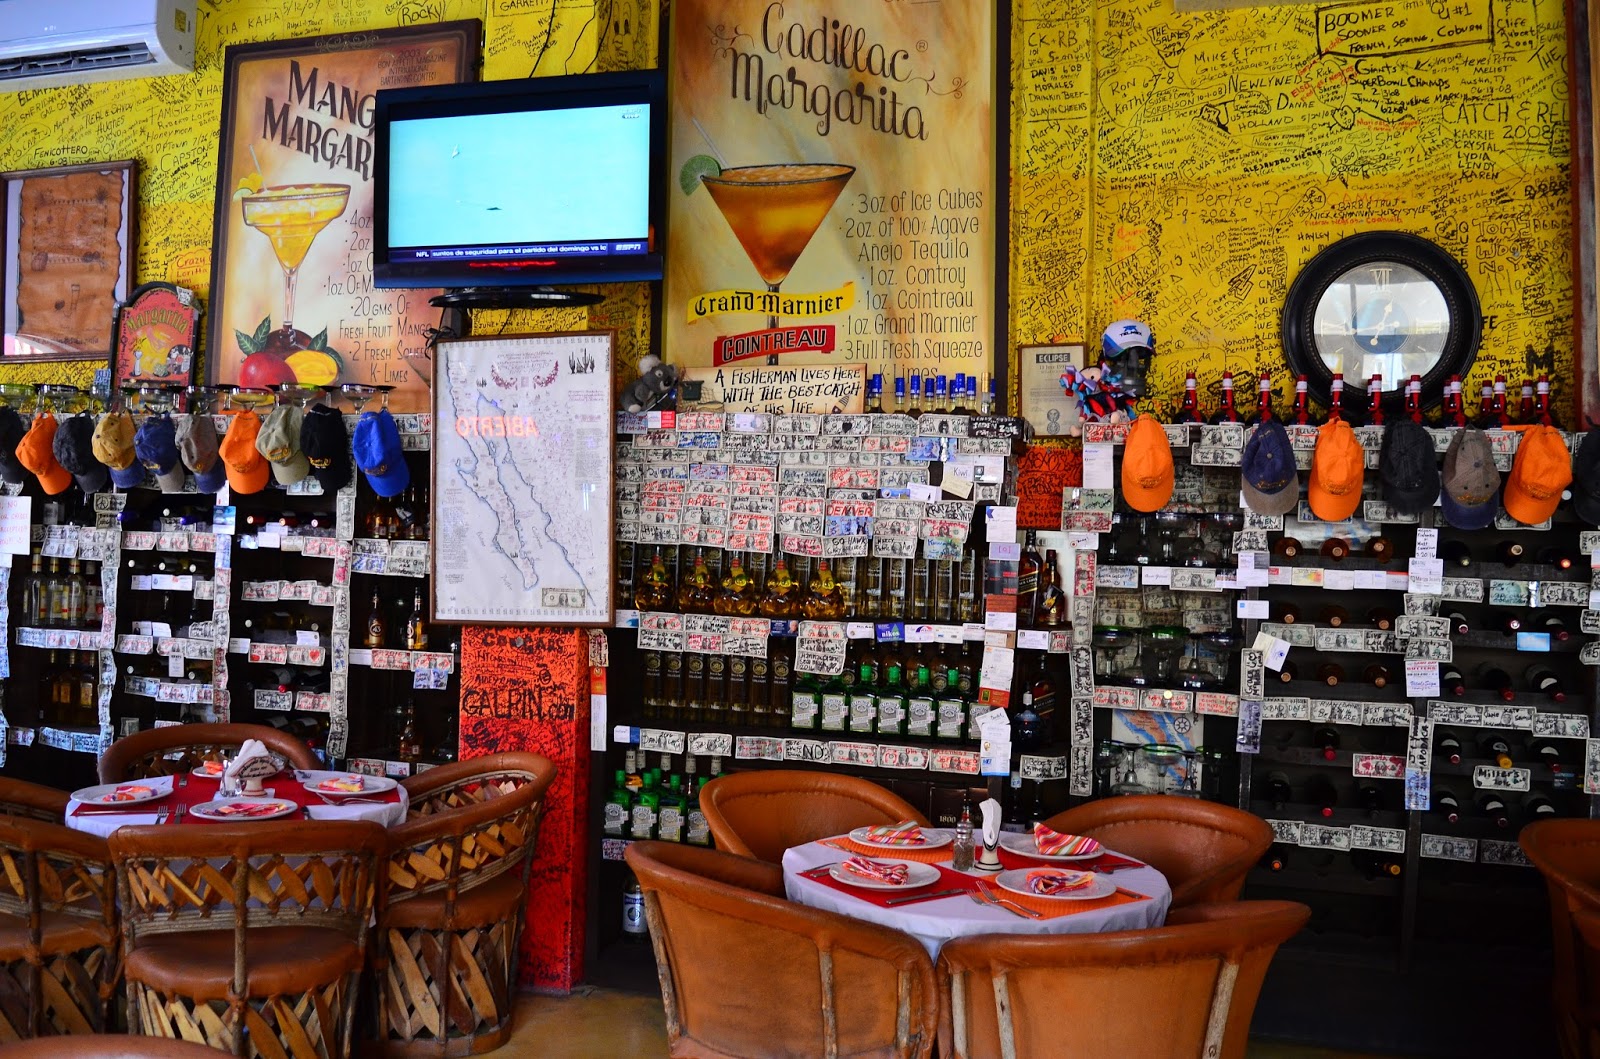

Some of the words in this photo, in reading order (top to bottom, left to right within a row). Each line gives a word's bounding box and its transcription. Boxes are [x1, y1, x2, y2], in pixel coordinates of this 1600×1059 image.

[1324, 7, 1395, 34] BOOMER
[762, 1, 912, 83] Cadillac
[288, 59, 376, 137] MANG
[727, 47, 929, 141] Margarita
[1441, 101, 1509, 125] CATCH
[262, 96, 376, 182] MARGAR
[891, 190, 907, 212] of
[911, 190, 932, 211] Ice
[938, 188, 983, 210] Cubes
[878, 216, 895, 238] of
[930, 215, 979, 240] Agave
[465, 248, 497, 256] seguridad
[522, 246, 546, 254] partido
[560, 245, 589, 253] domingo
[909, 237, 969, 264] Tequila
[906, 264, 966, 289] Controy
[757, 293, 844, 316] Marnier
[897, 288, 974, 310] Cointreau
[339, 319, 364, 340] FRESH
[367, 318, 392, 339] FRUIT
[874, 312, 916, 335] Grand
[920, 312, 978, 334] Marnier
[364, 341, 392, 361] FRESH
[722, 328, 827, 363] COINTREAU
[856, 340, 878, 360] Full
[882, 338, 920, 360] Fresh
[923, 338, 983, 363] Squeeze
[1038, 354, 1068, 363] ECLIPSE
[715, 368, 725, 387] A
[833, 366, 861, 380] HERE
[723, 386, 755, 403] WITH
[760, 386, 783, 401] THE
